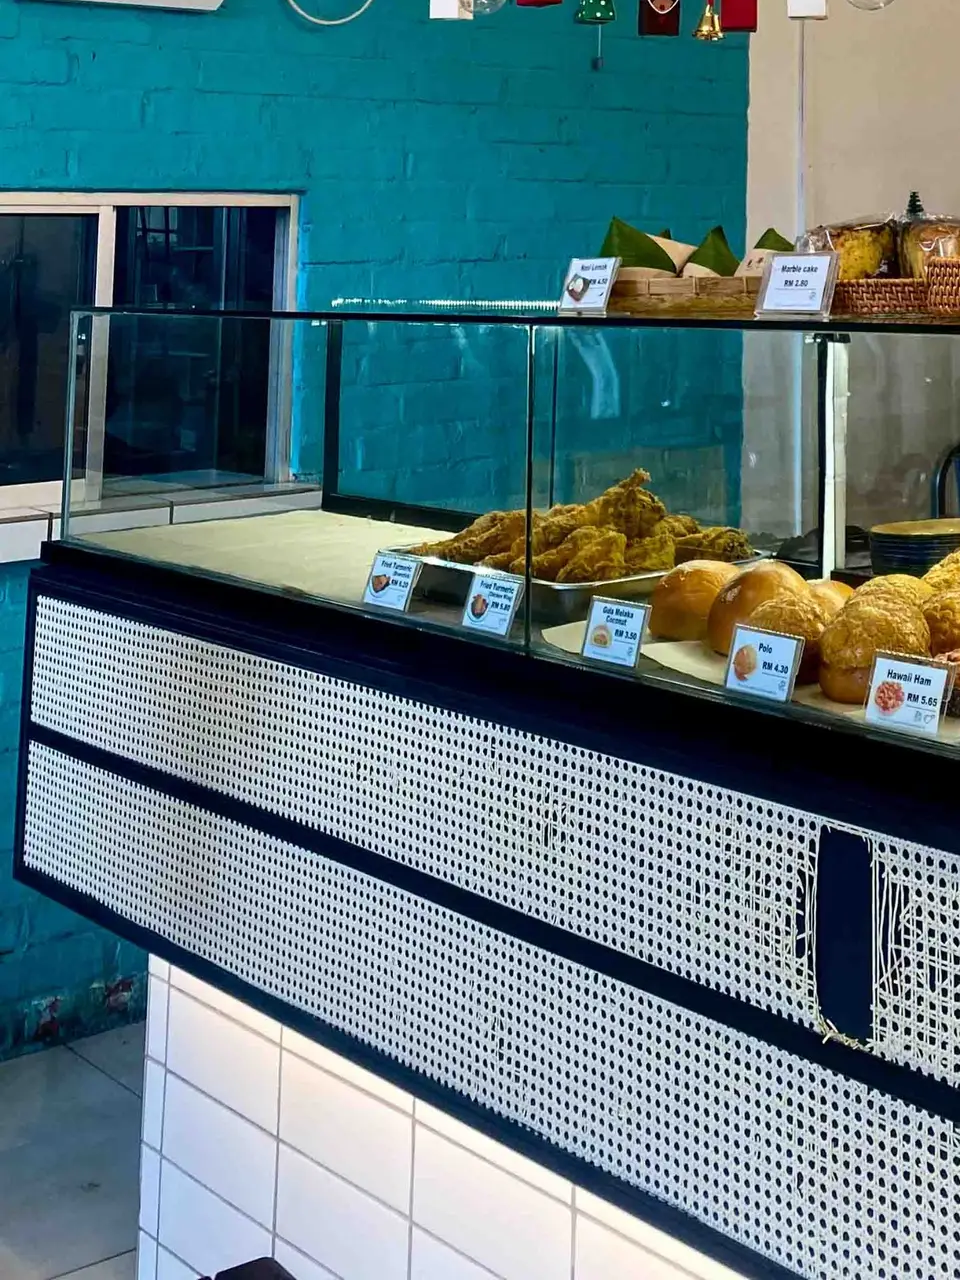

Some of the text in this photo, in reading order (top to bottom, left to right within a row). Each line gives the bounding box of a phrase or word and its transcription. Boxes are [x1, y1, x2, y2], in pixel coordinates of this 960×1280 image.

[603, 606, 634, 618] Gula Melaka
[615, 629, 637, 640] RM 3.50
[759, 643, 772, 654] Polo
[762, 661, 788, 675] RM 4.30
[887, 669, 931, 686] Hawaii Ham
[907, 692, 937, 707] RM 5.65
